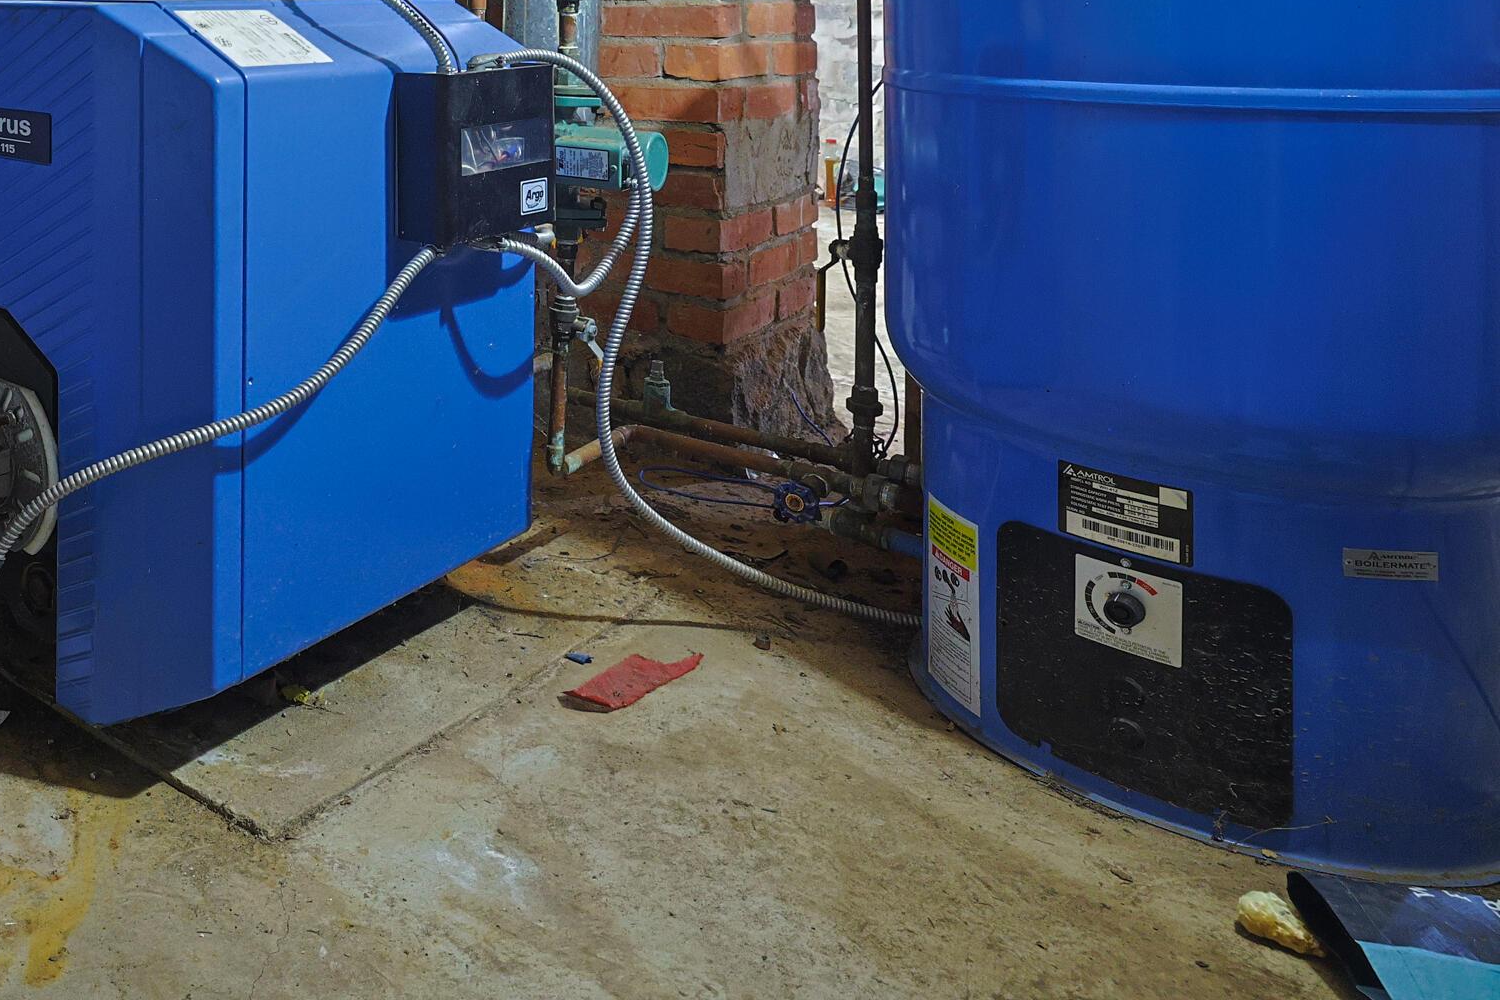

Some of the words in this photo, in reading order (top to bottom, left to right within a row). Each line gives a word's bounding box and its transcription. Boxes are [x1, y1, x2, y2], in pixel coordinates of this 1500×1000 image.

[525, 189, 544, 201] Argo
[1077, 470, 1115, 485] AMTROL
[939, 552, 963, 576] DANGER
[1354, 559, 1427, 569] BOILERMATE
